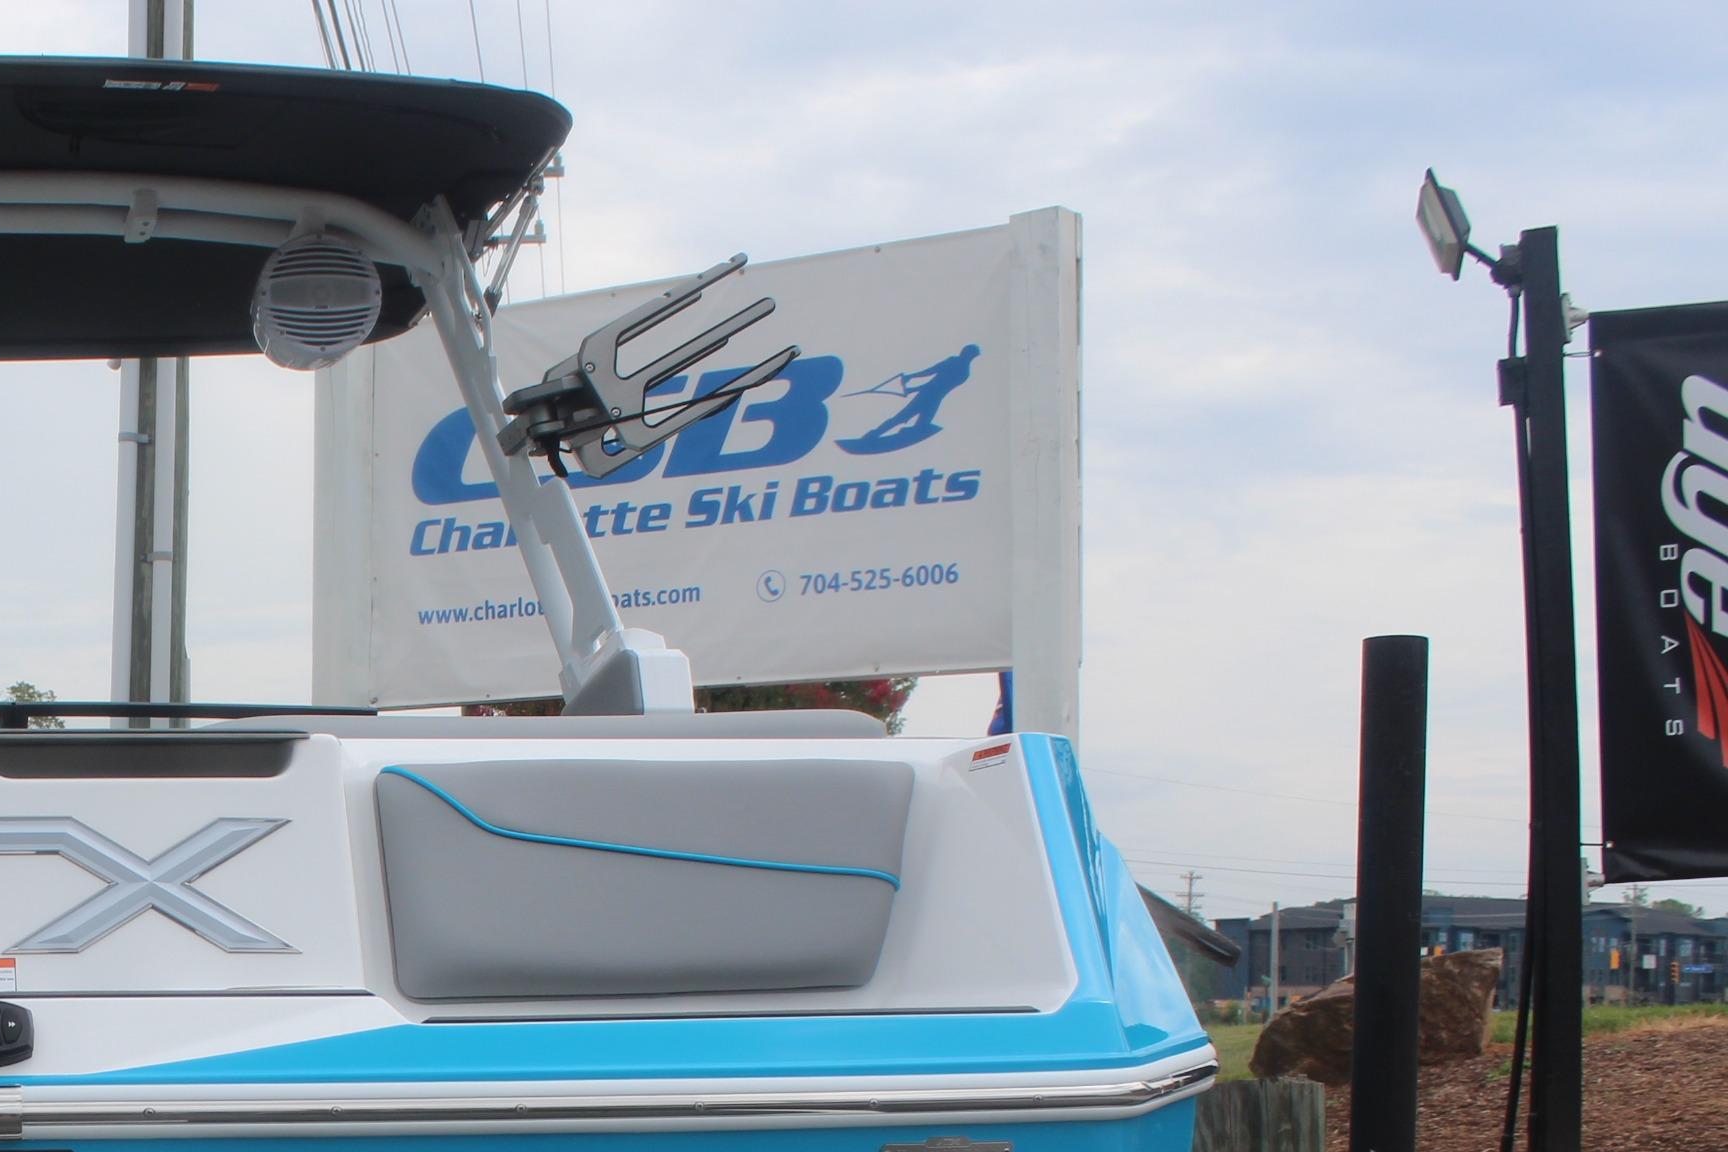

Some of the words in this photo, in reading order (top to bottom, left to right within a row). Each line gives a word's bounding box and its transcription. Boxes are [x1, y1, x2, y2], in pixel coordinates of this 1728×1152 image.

[410, 501, 672, 557] Chatte
[684, 480, 780, 529] Ski
[789, 468, 982, 518] Boats
[799, 562, 960, 597] 704-525-6006
[1660, 543, 1684, 736] BOATS
